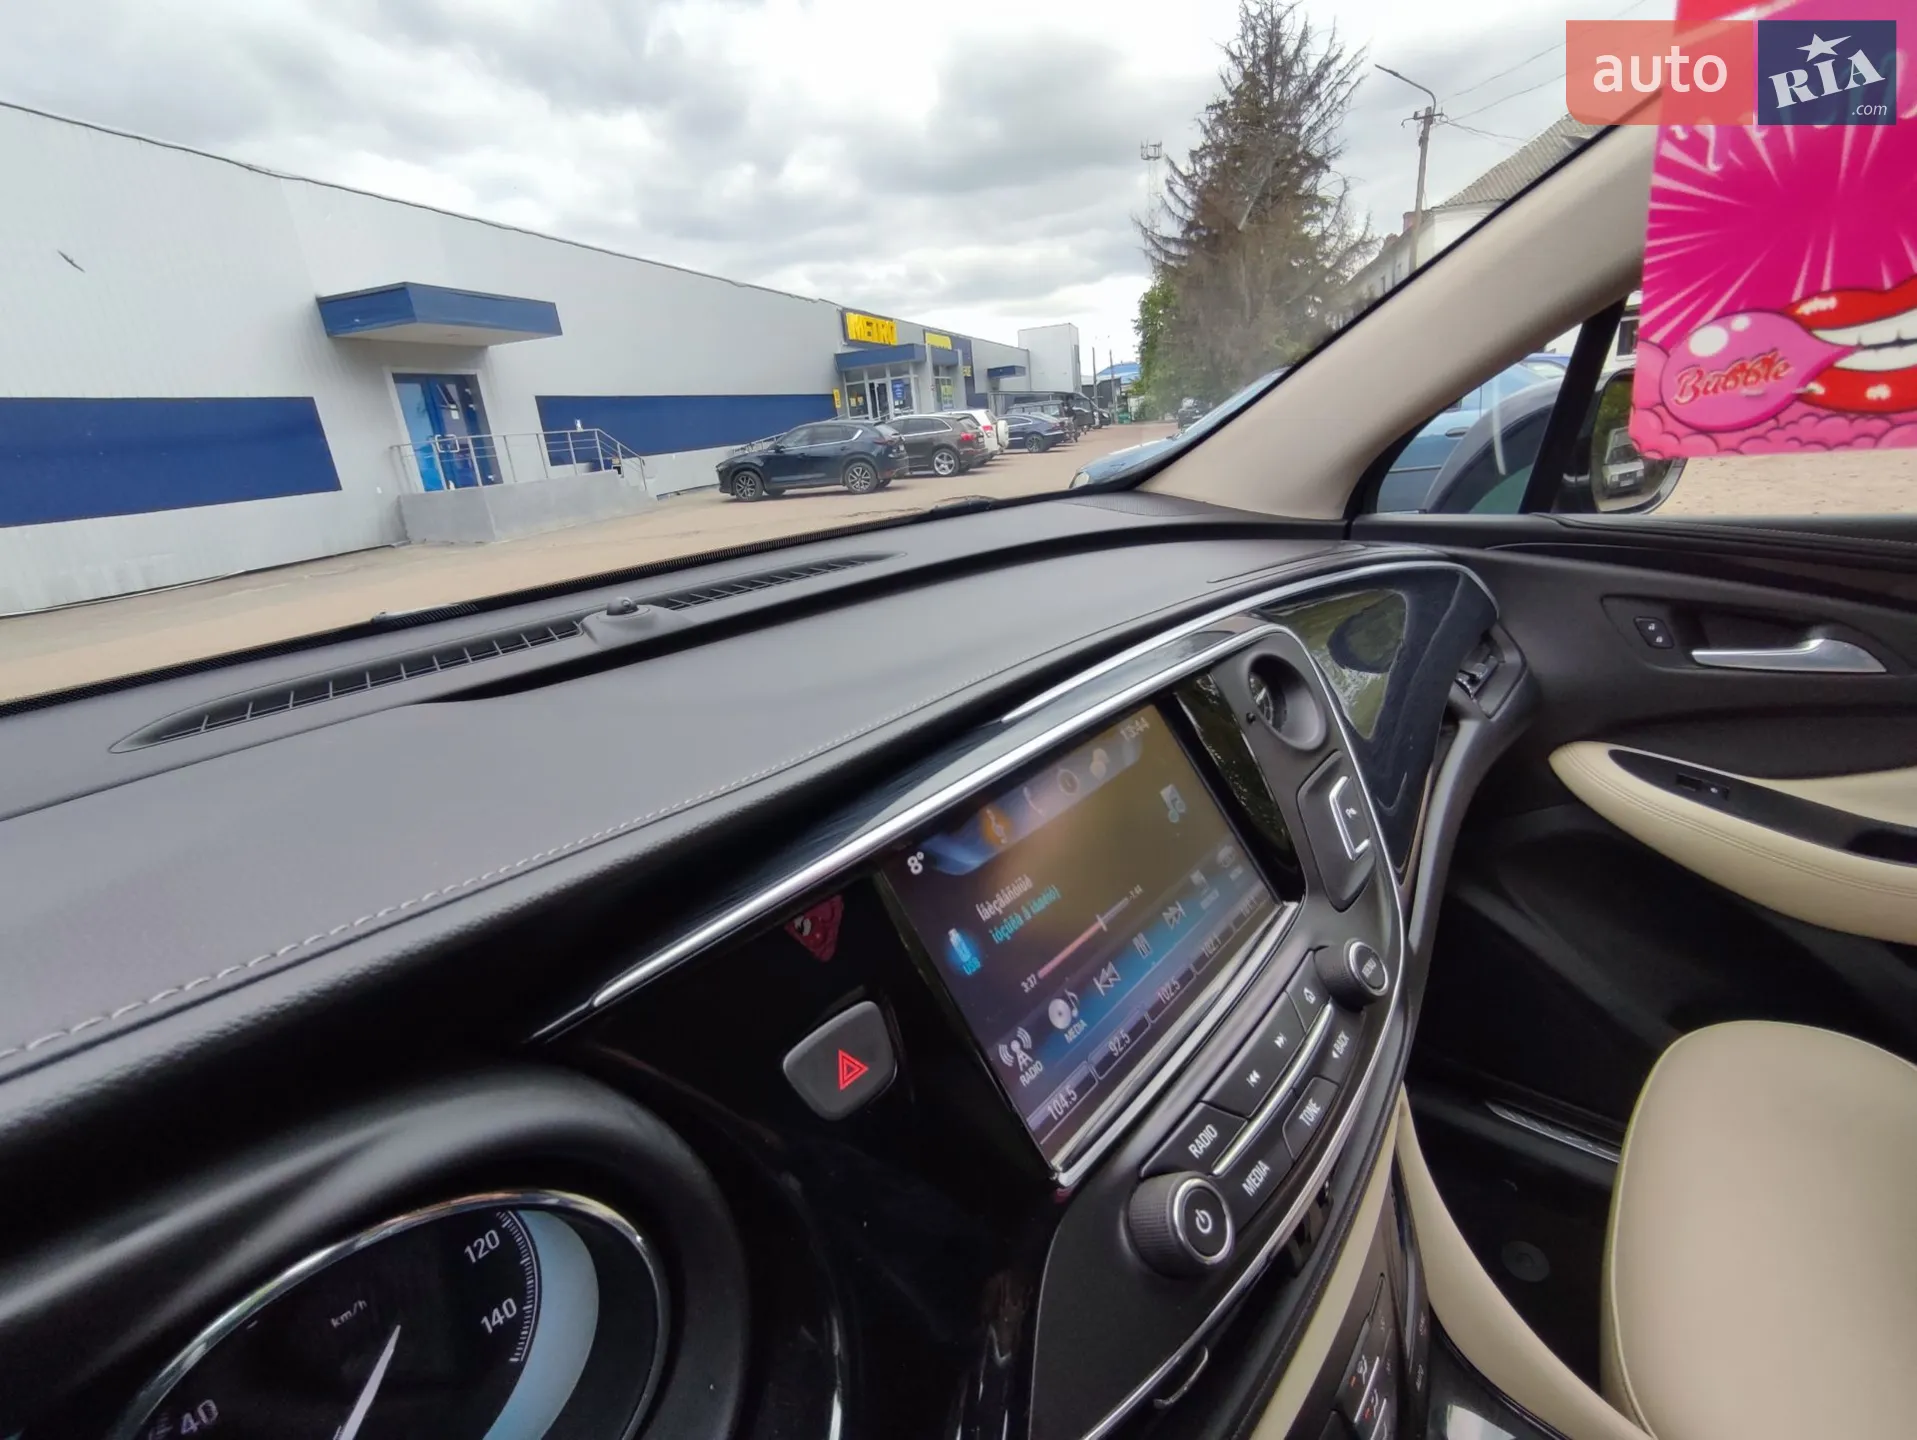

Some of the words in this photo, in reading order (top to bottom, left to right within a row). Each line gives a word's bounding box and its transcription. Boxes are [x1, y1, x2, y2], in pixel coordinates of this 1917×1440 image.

[846, 312, 897, 346] METRO
[1674, 348, 1793, 404] Bubble
[1021, 973, 1037, 993] 3:37
[1157, 976, 1181, 1004] 102.5
[1064, 1019, 1088, 1044] MEDIA
[1108, 1029, 1131, 1057] 92.5
[1333, 1028, 1350, 1054] BACK
[1020, 1060, 1043, 1087] RADIO
[1047, 1084, 1077, 1120] 104.5
[1299, 1098, 1322, 1127] TONE
[1188, 1124, 1218, 1159] RADIO
[1242, 1160, 1271, 1197] MEDIA
[464, 1229, 500, 1263] 120
[331, 1299, 368, 1328] km/h
[481, 1298, 517, 1334] 140
[180, 1398, 219, 1436] 40
